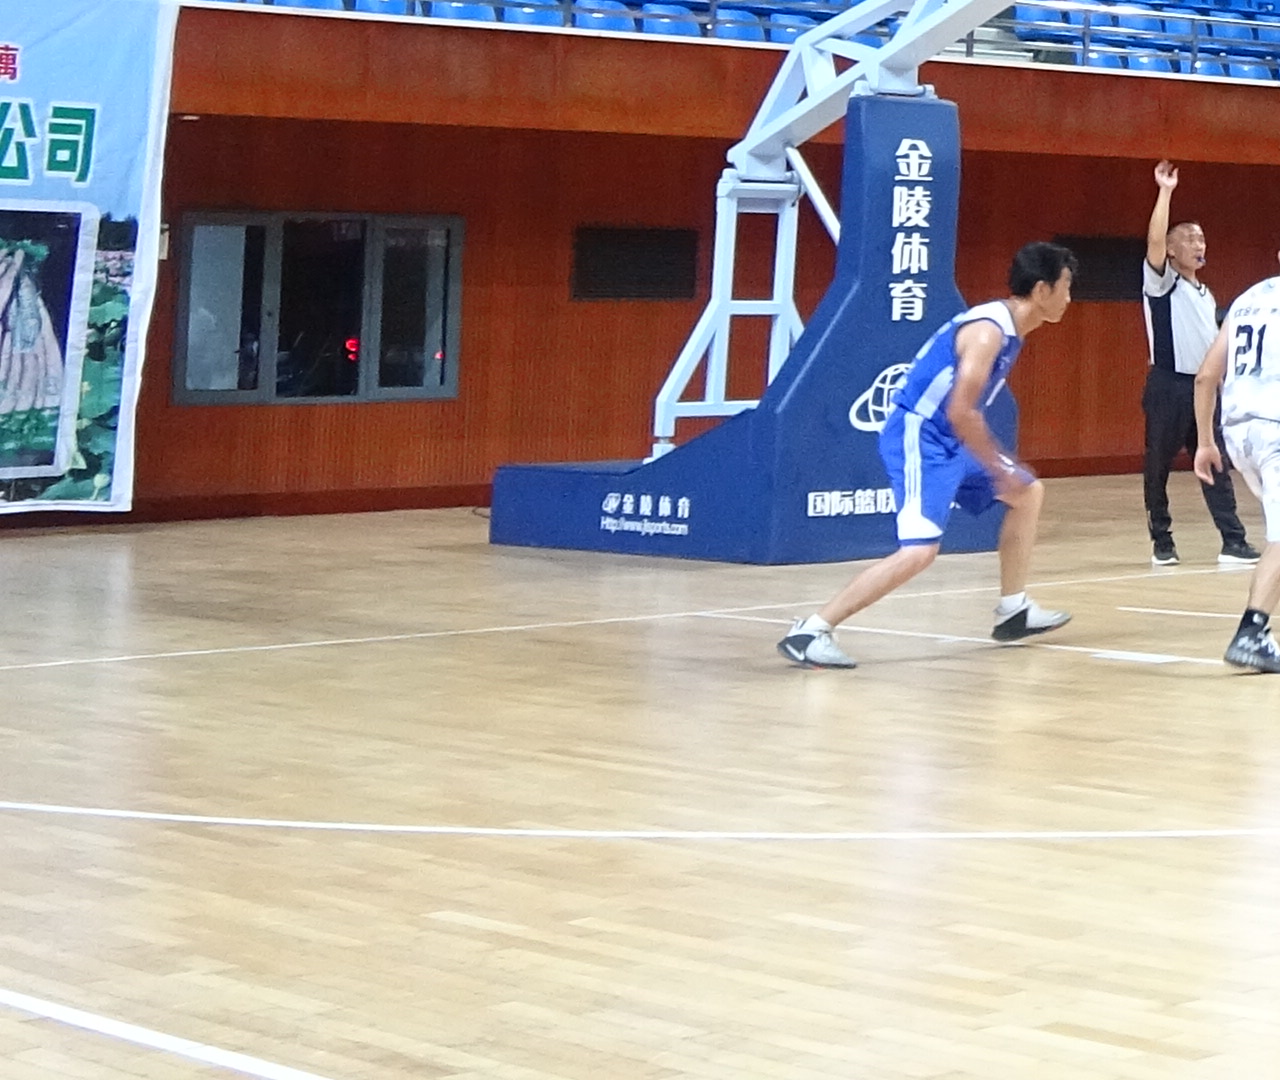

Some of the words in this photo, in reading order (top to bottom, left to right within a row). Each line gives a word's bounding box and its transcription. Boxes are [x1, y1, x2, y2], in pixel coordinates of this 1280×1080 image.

[0, 101, 97, 183] 公司
[888, 138, 933, 321] 金陵体育
[1234, 323, 1267, 378] 21
[807, 488, 897, 517] 国际篮联
